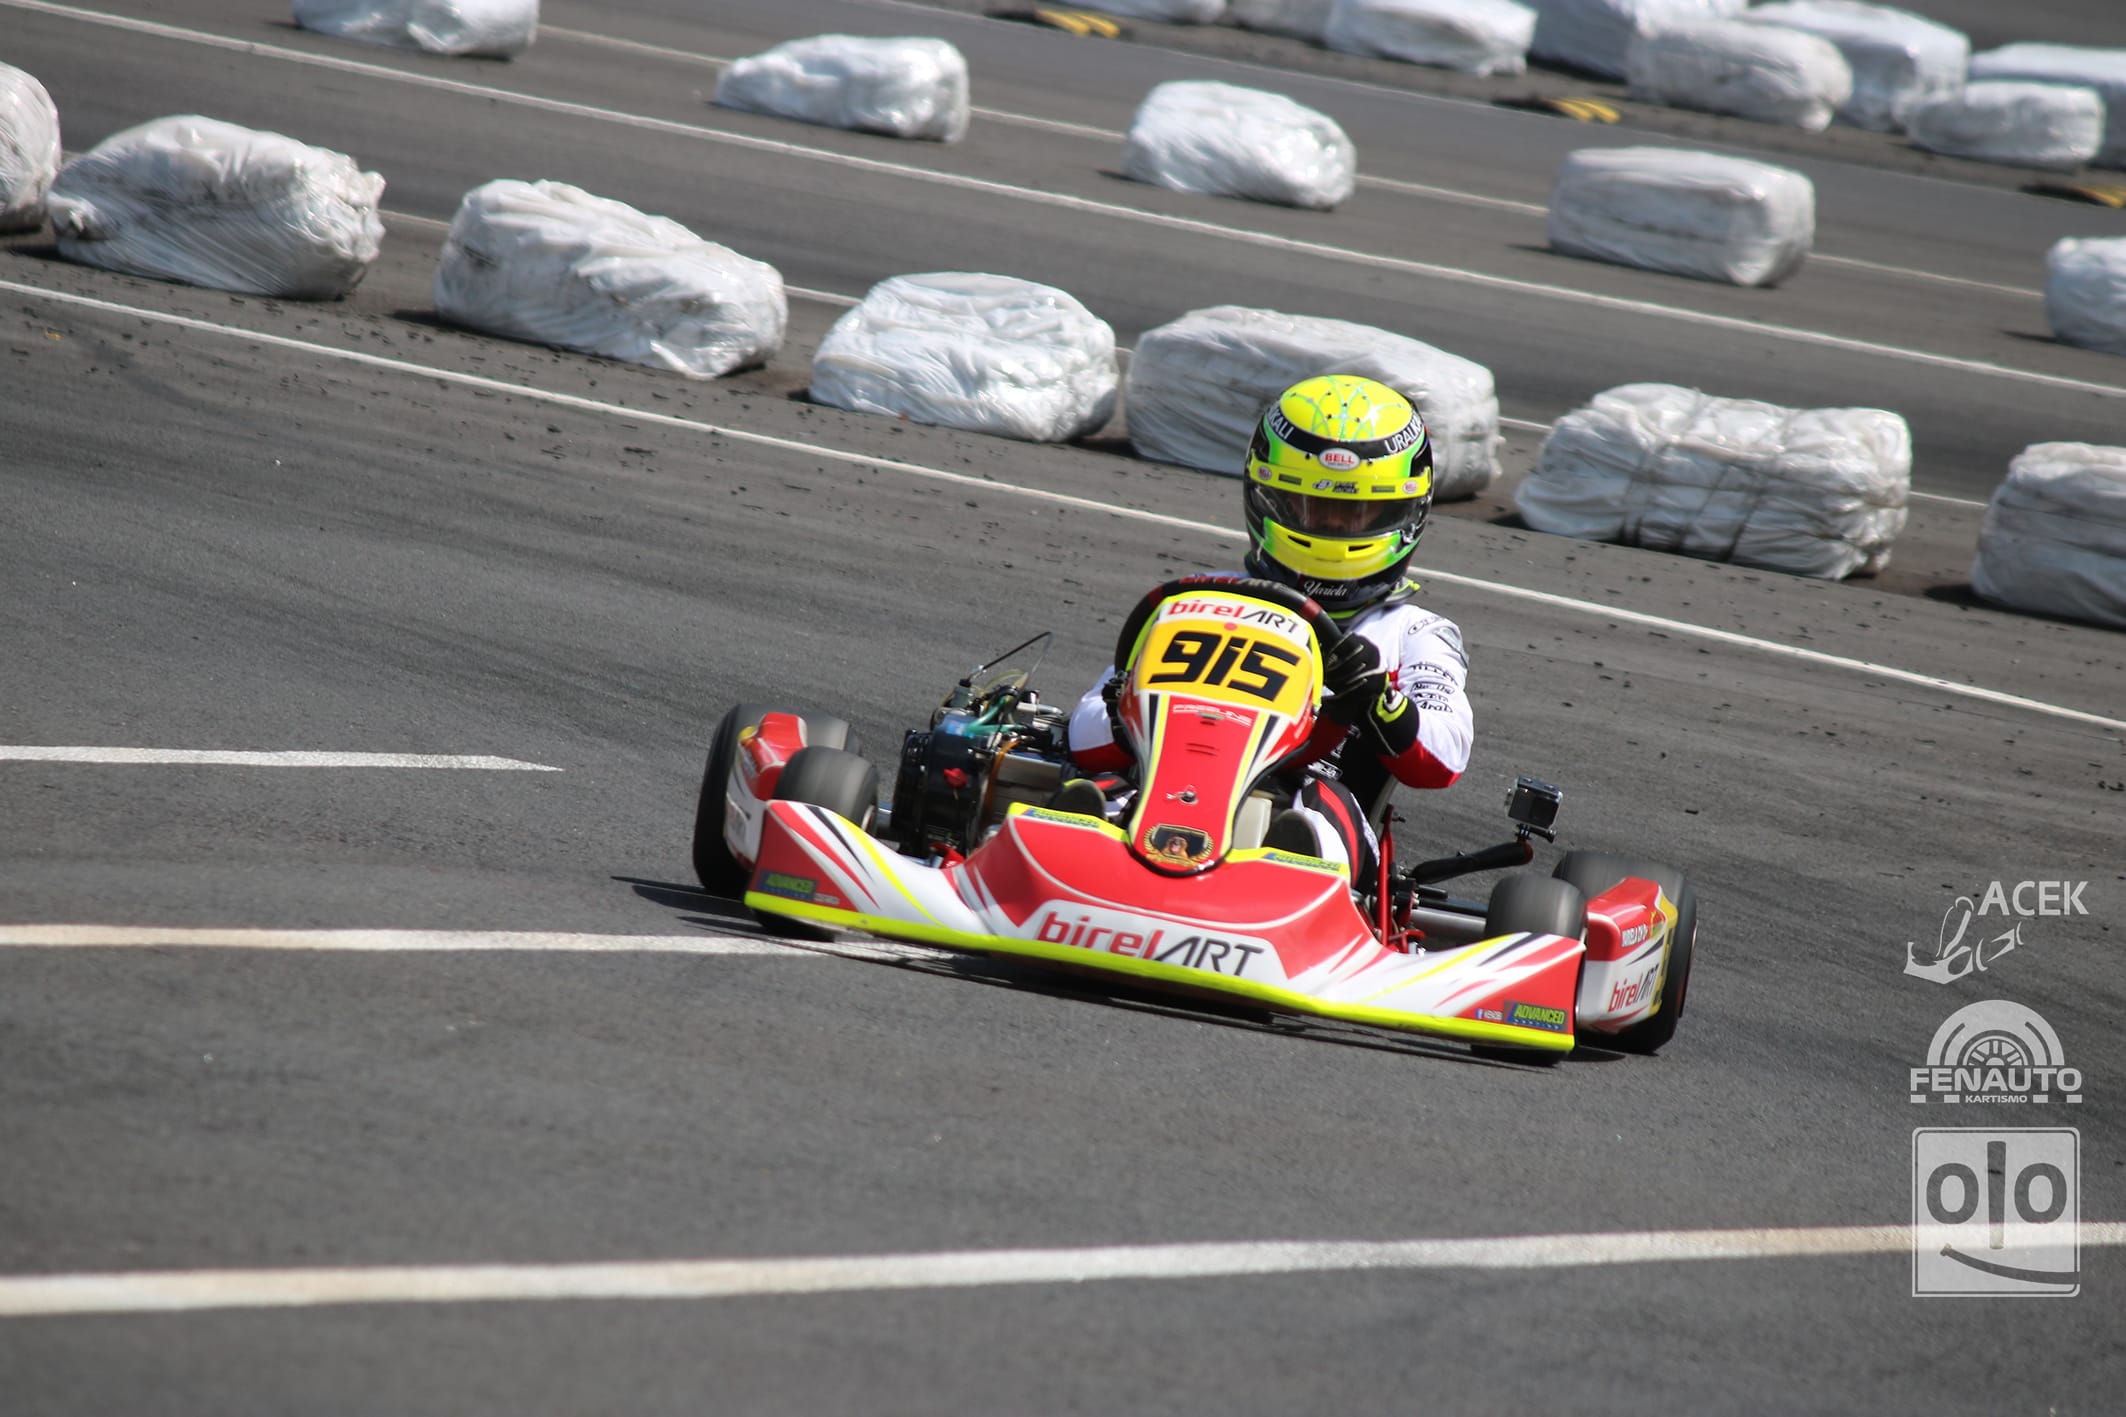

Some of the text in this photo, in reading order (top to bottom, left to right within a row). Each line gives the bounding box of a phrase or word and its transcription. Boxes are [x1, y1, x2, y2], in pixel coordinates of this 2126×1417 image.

[1325, 452, 1355, 465] BELL
[1167, 599, 1299, 633] birelART
[1036, 911, 1264, 977] birelART
[1513, 1004, 1565, 1025] ADVANCED
